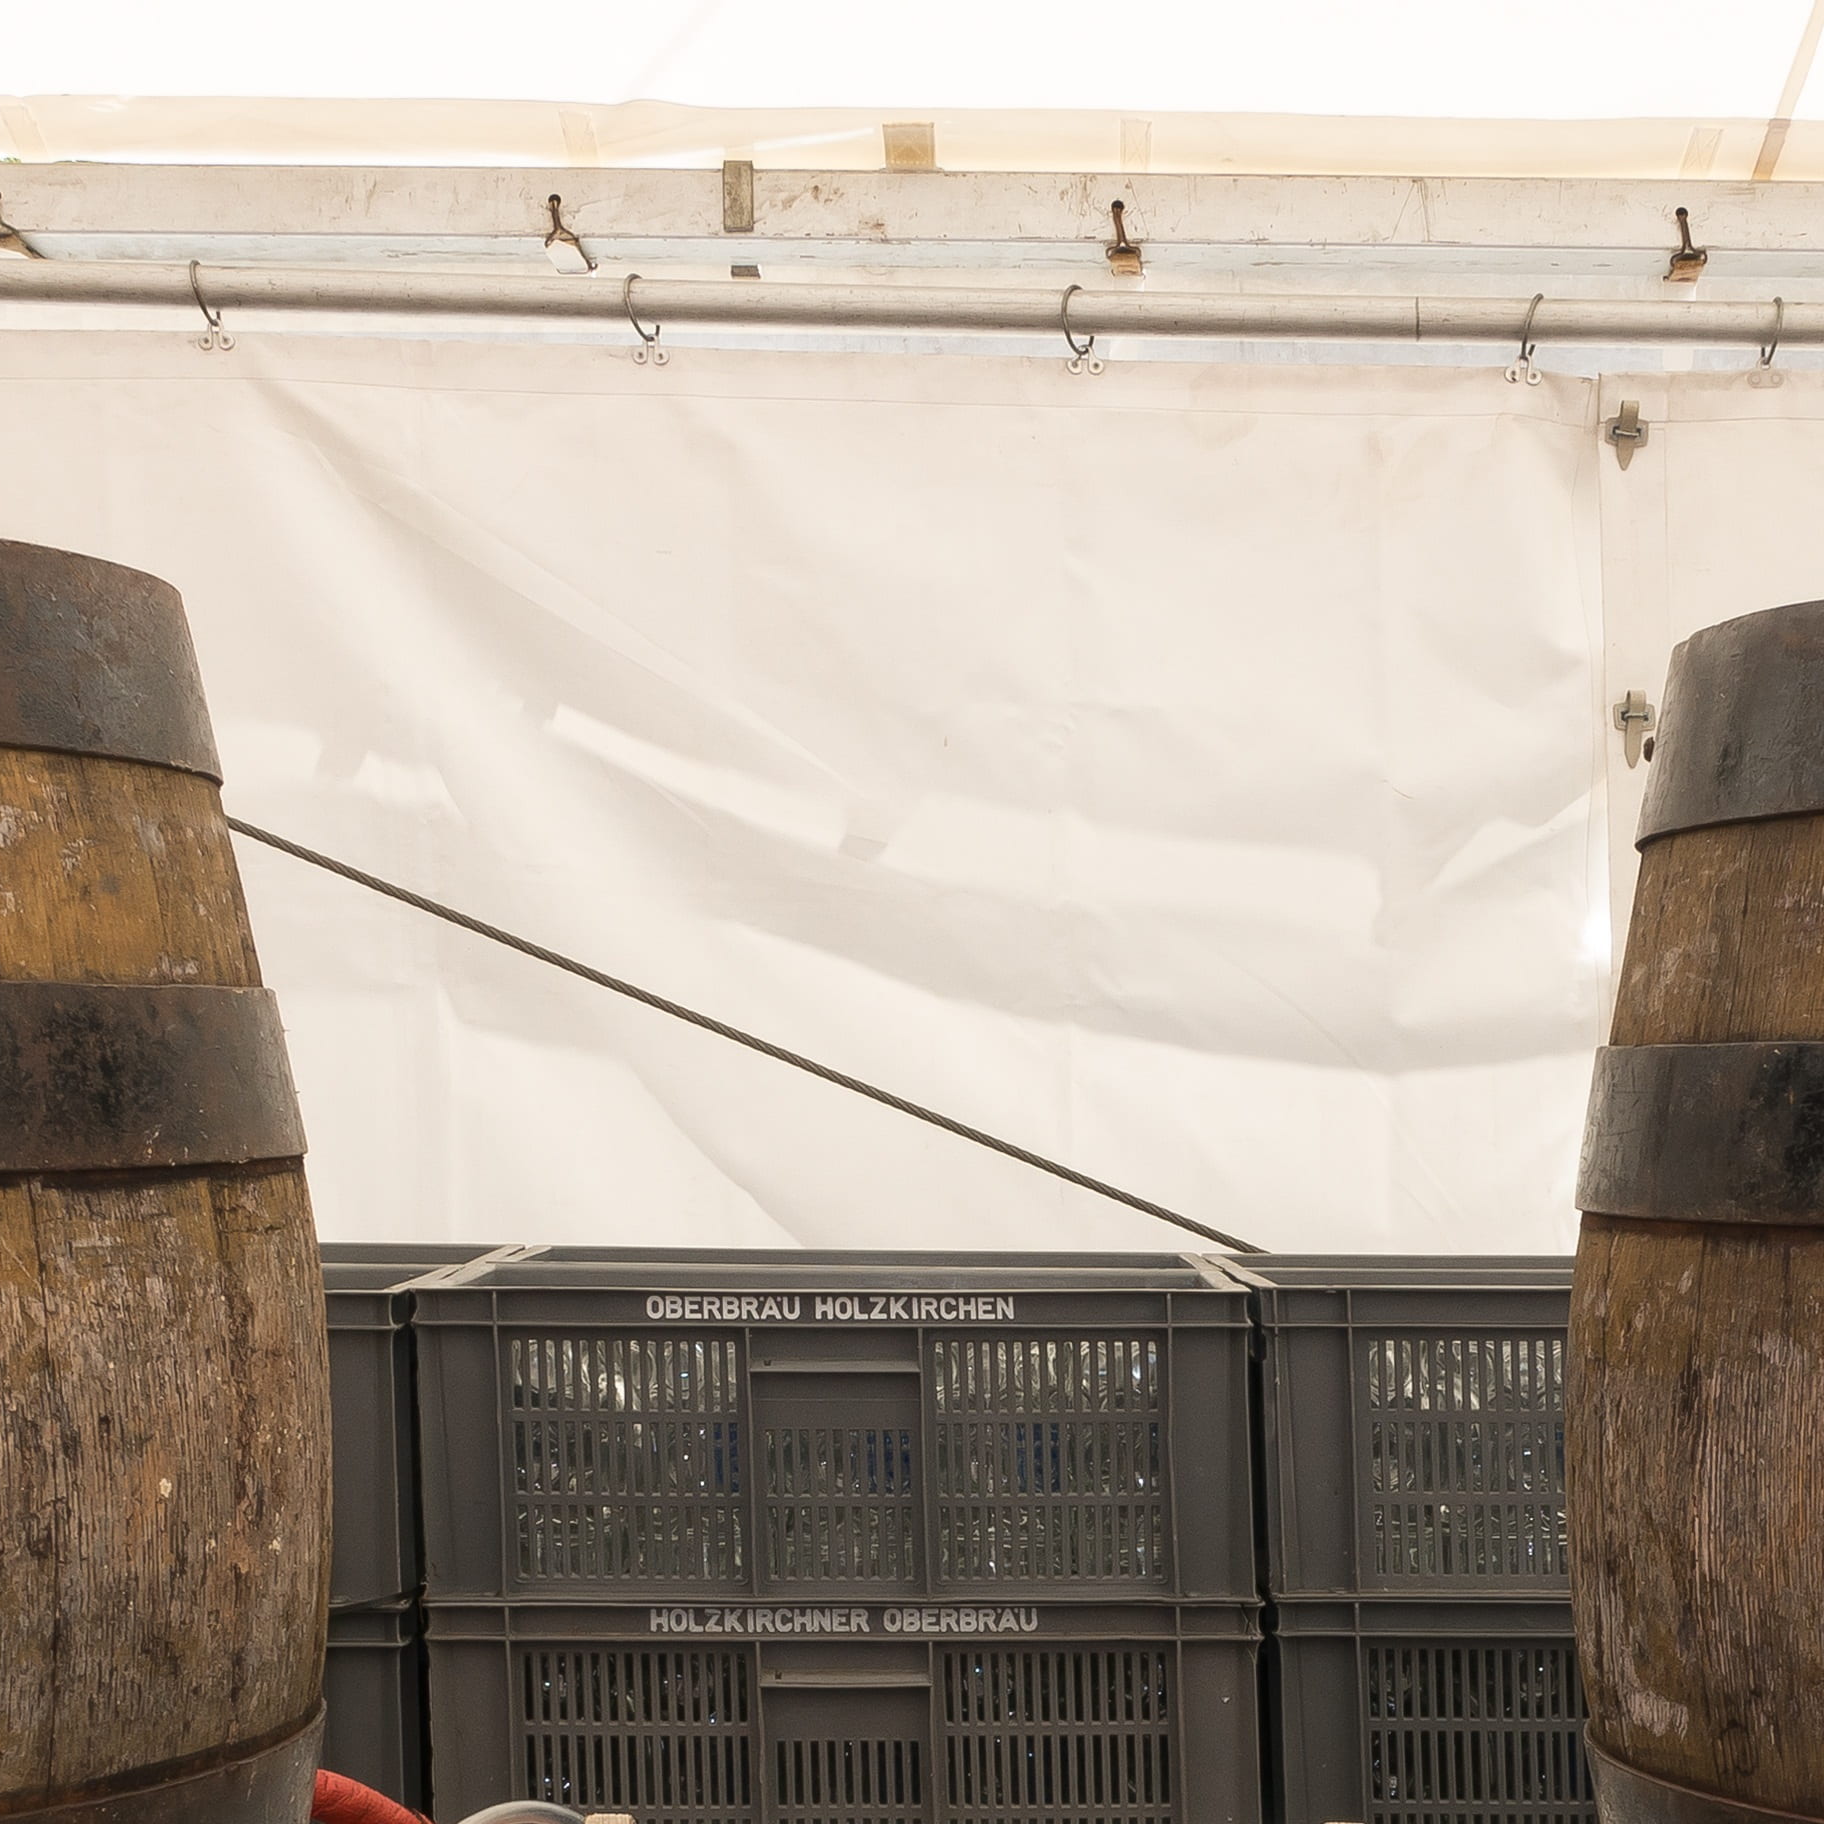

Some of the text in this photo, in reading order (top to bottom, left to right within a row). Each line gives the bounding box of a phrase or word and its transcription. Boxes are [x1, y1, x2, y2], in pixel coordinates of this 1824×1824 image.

[646, 1294, 1015, 1321] OBERBRÄU HOLZKIRCHEN
[650, 1607, 1039, 1634] HOLZKIRCHNER OBERBRÄU
